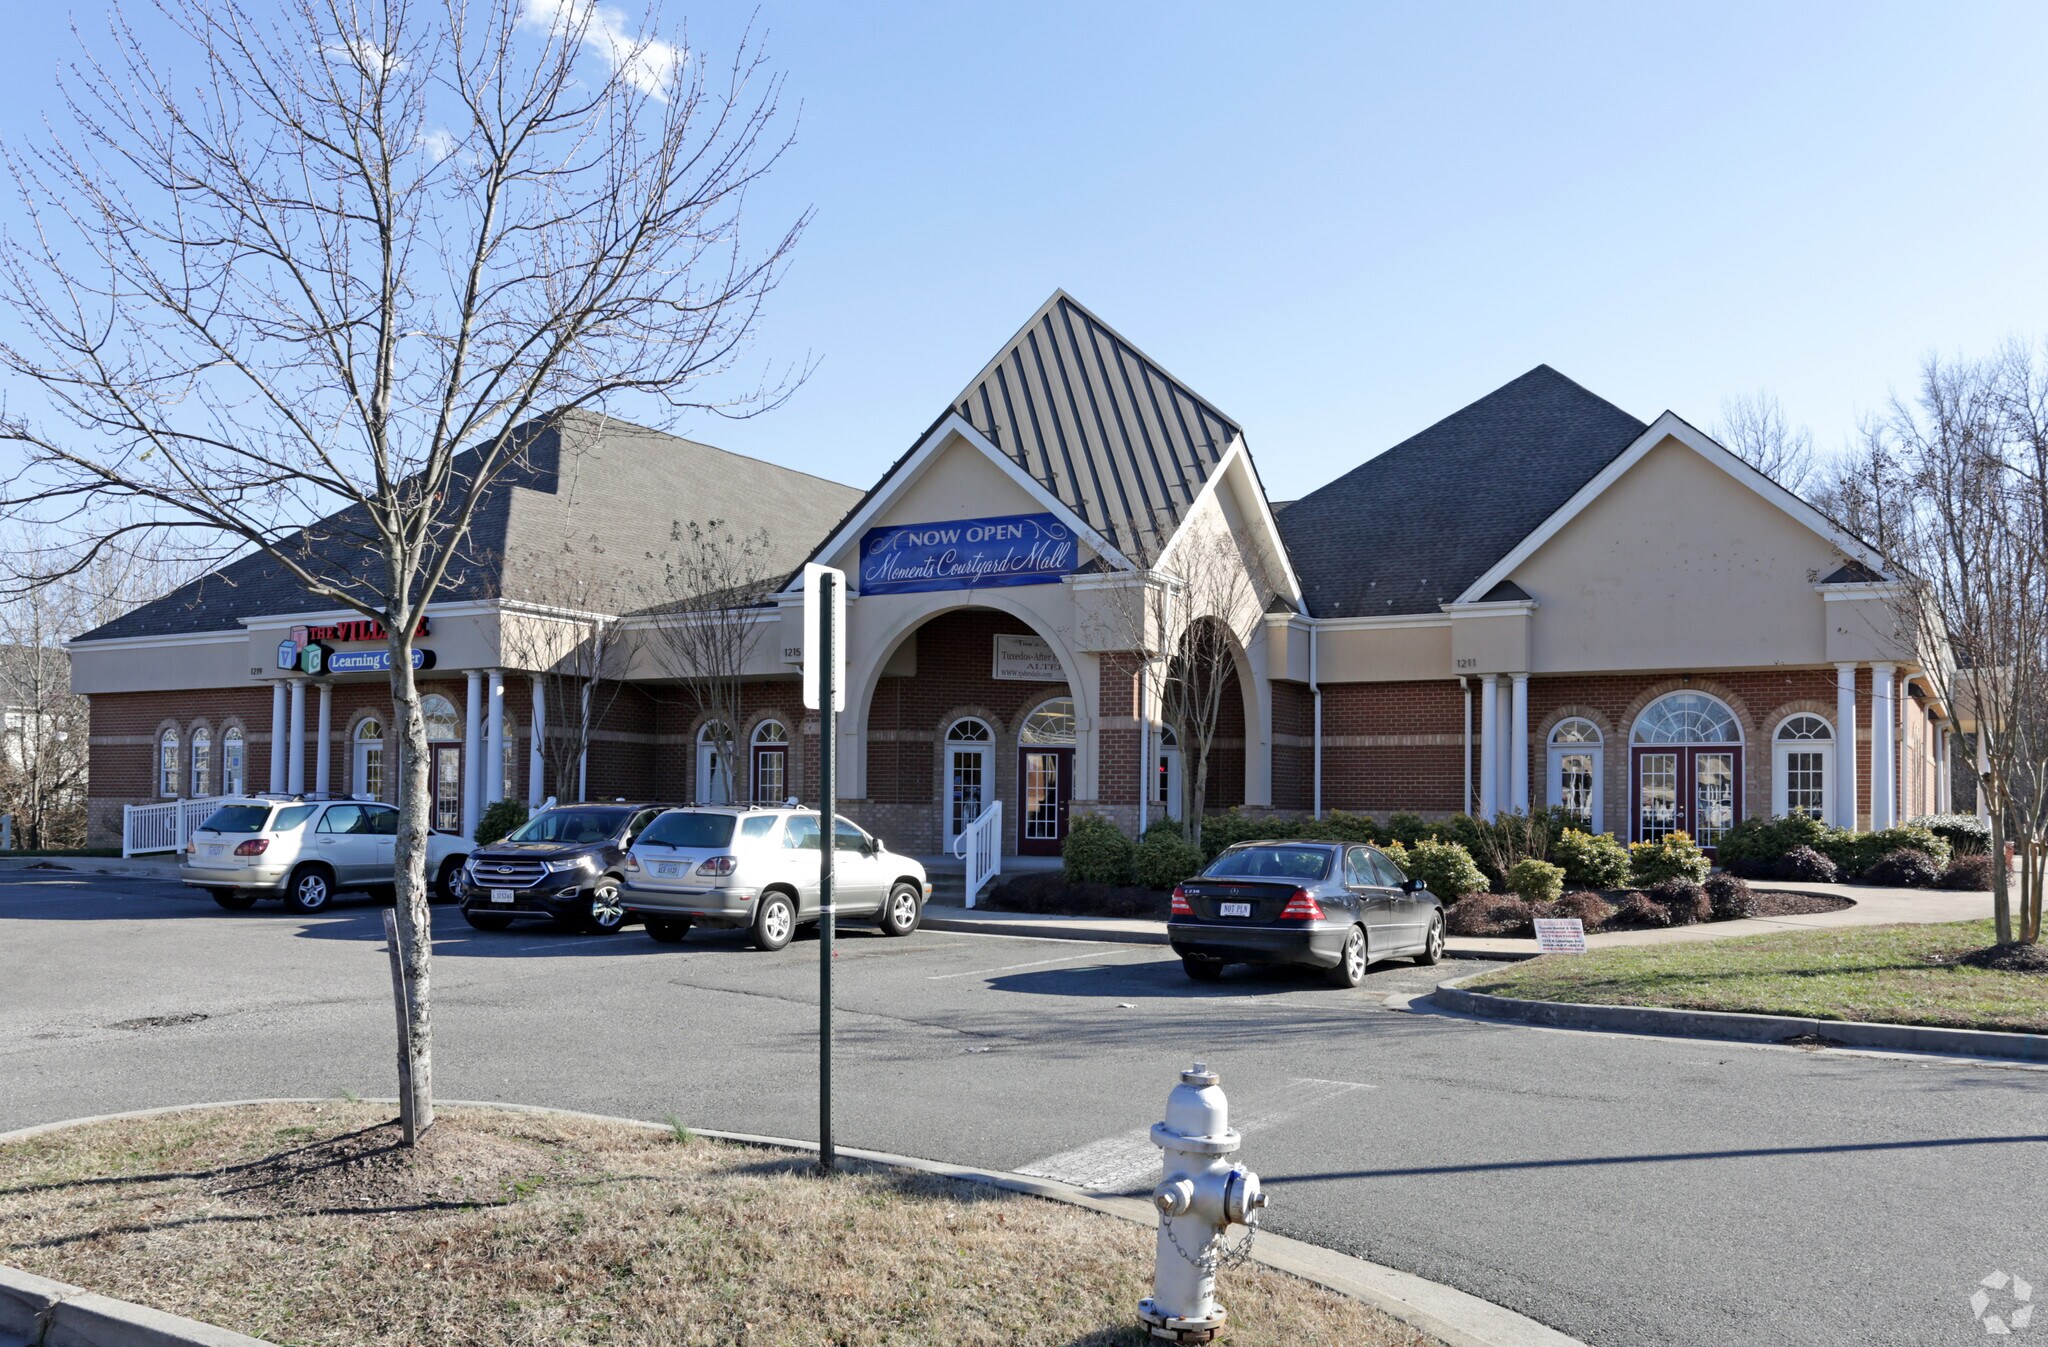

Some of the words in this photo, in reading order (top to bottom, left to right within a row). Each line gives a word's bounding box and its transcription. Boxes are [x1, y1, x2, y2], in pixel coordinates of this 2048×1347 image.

[908, 529, 961, 547] NOW
[966, 524, 1022, 542] OPEN
[865, 551, 934, 581] Moments
[936, 547, 1014, 583] Courtyard
[1011, 539, 1071, 571] Mall
[309, 626, 335, 640] THE
[336, 616, 426, 642] VILLE
[281, 651, 290, 666] V
[784, 647, 801, 657] 1215
[310, 653, 320, 669] C
[332, 654, 381, 669] Learning
[383, 653, 421, 665] Cer
[1457, 658, 1476, 668] 1211
[250, 667, 262, 675] 1219
[1224, 905, 1235, 913] NOT
[1236, 905, 1248, 914] PLN
